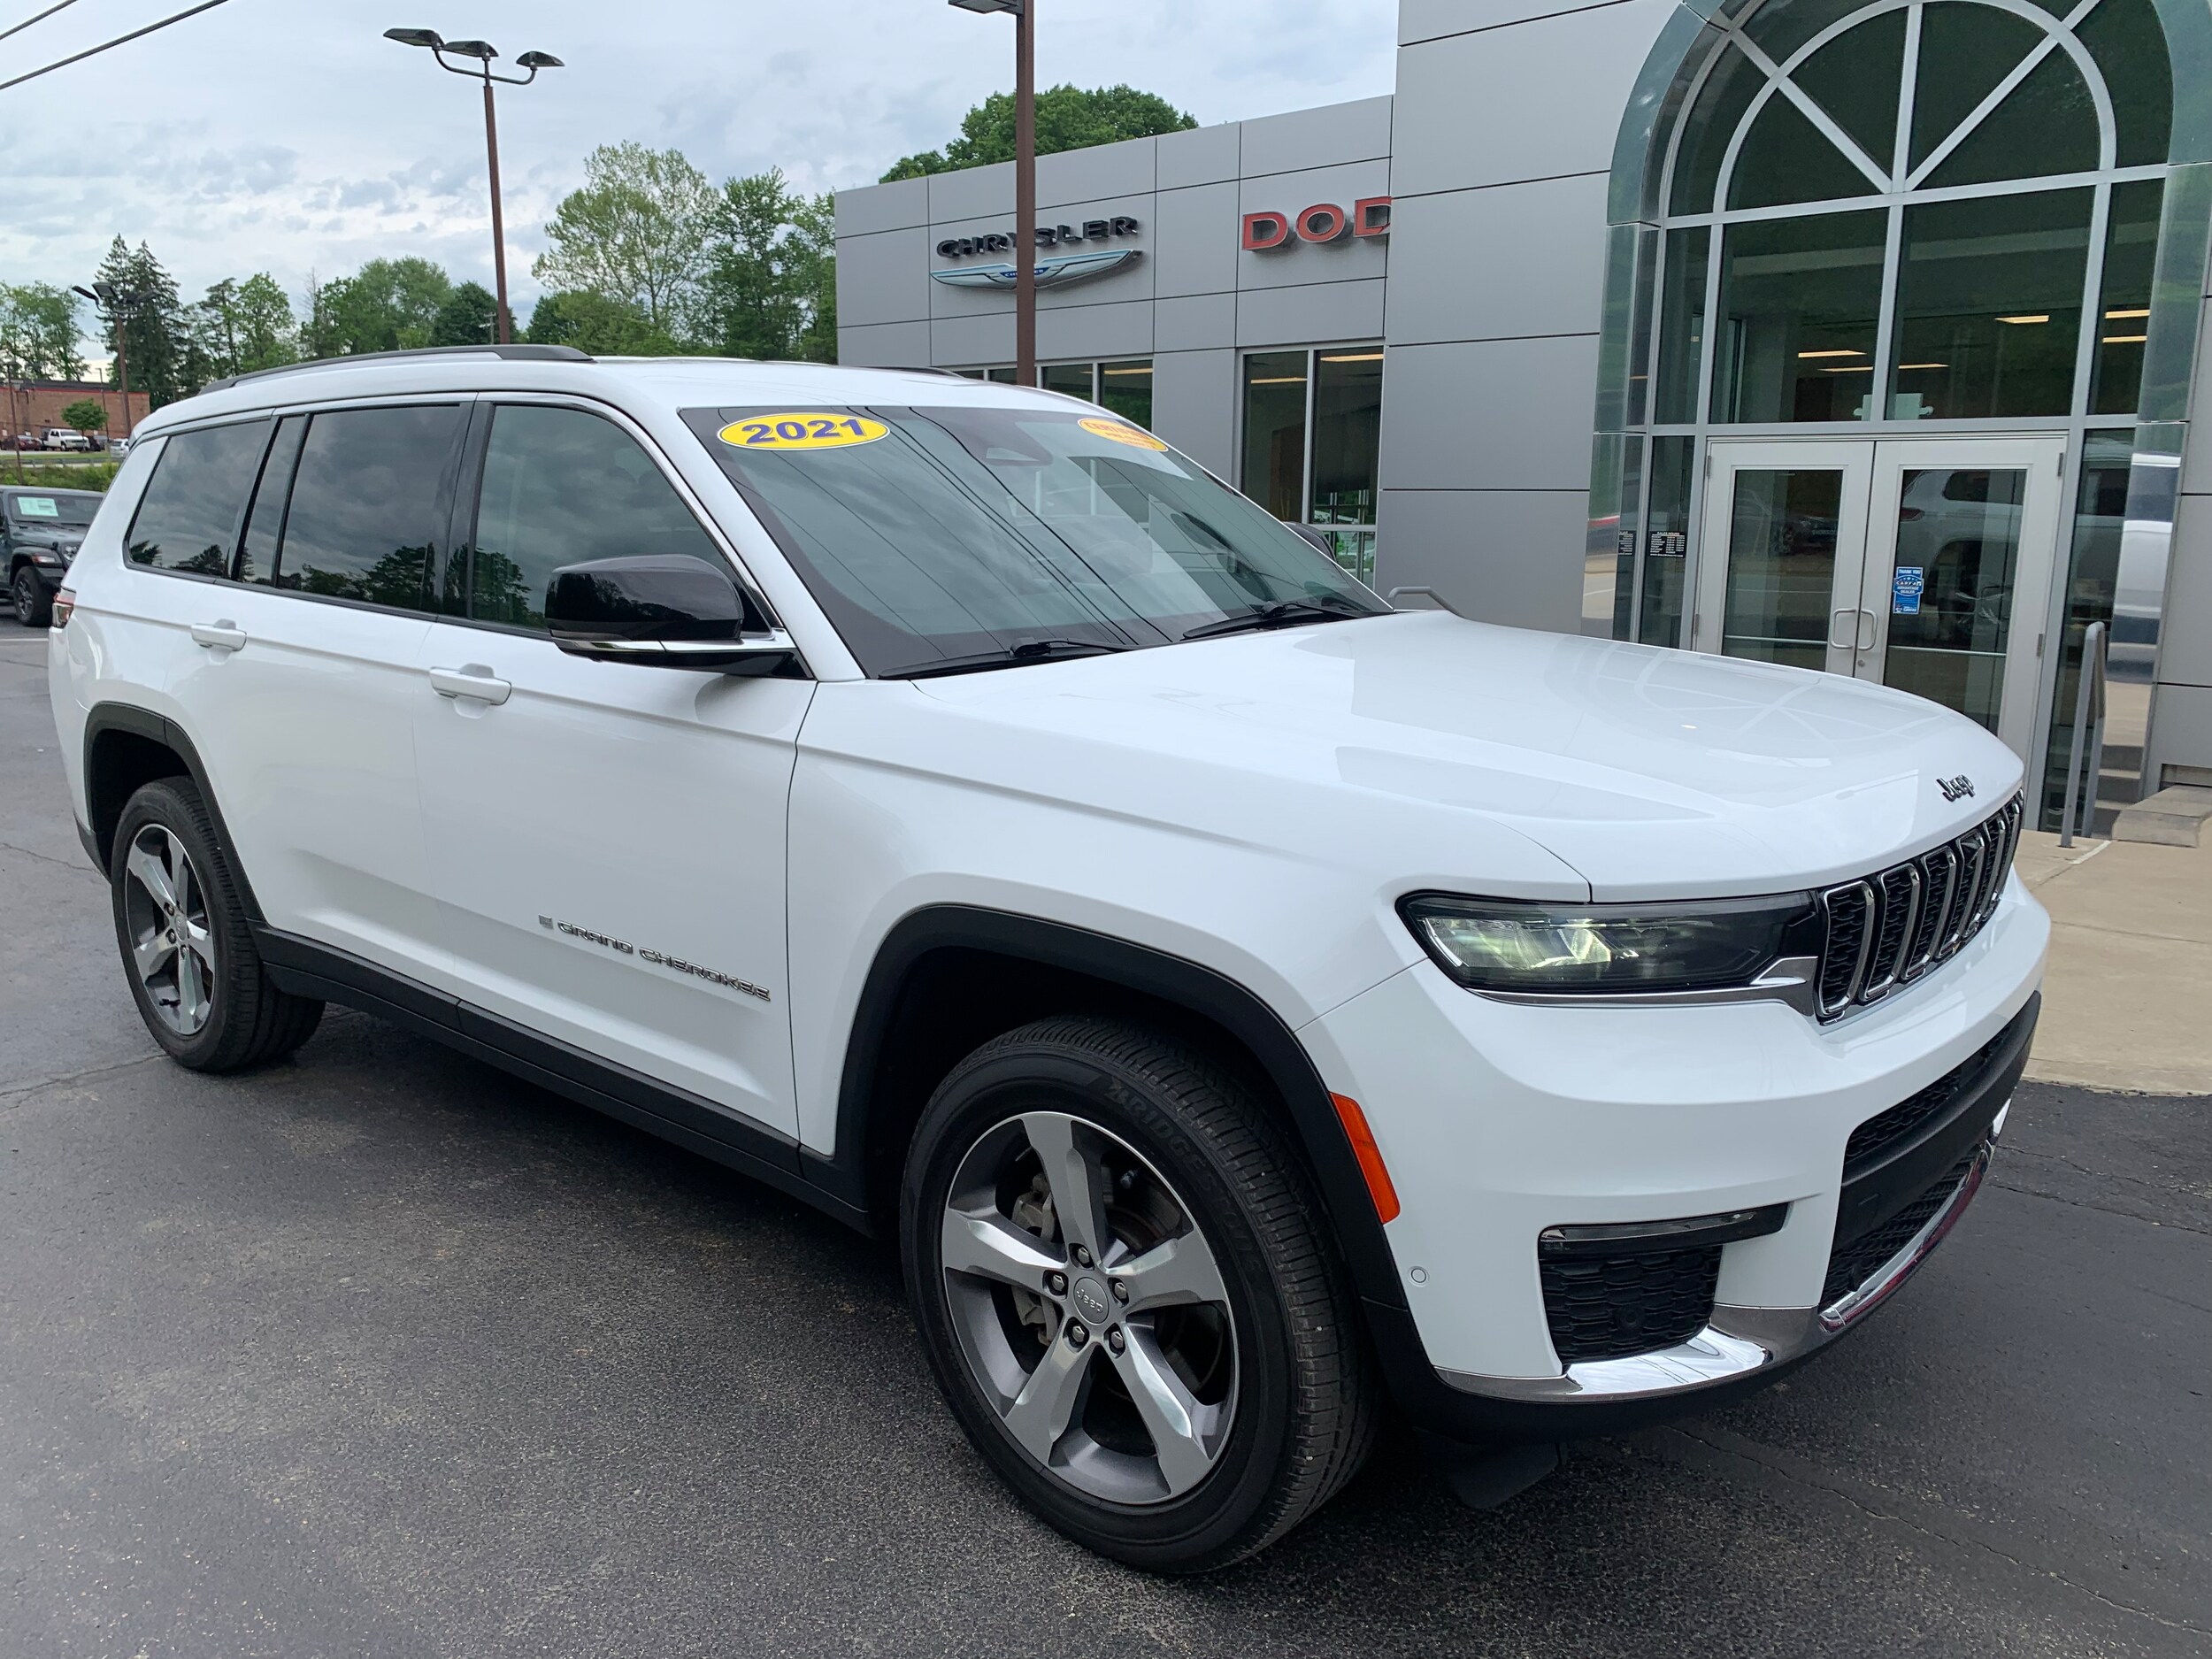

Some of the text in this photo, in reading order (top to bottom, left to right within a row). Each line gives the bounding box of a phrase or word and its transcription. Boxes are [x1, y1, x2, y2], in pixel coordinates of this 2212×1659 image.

[741, 419, 867, 444] 2021
[1936, 774, 1976, 803] Jeep
[557, 920, 772, 1002] GRAND CHEROKEE
[1076, 1288, 1103, 1314] Jeep
